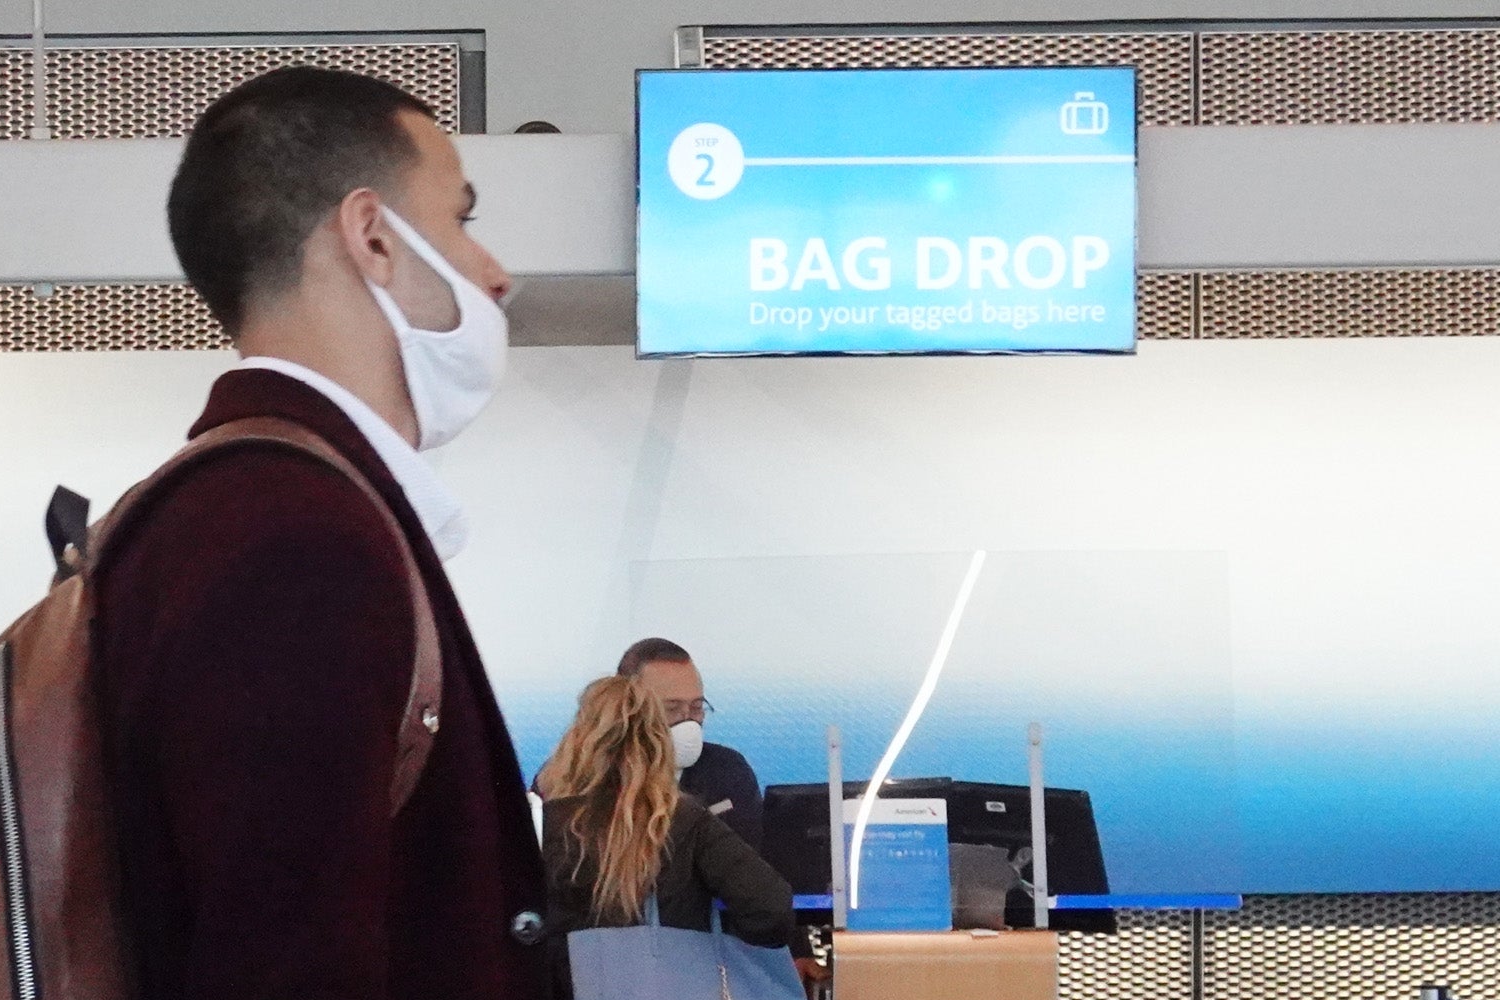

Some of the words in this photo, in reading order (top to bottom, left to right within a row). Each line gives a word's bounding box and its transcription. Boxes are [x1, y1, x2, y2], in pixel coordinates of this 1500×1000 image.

[694, 138, 719, 147] STEP
[695, 153, 716, 186] 2
[750, 237, 892, 292] BAG
[916, 235, 1111, 290] DROP
[750, 302, 813, 329] Drop
[817, 305, 879, 332] your
[886, 302, 973, 330] tagged
[981, 301, 1041, 330] bags
[1048, 300, 1106, 322] here
